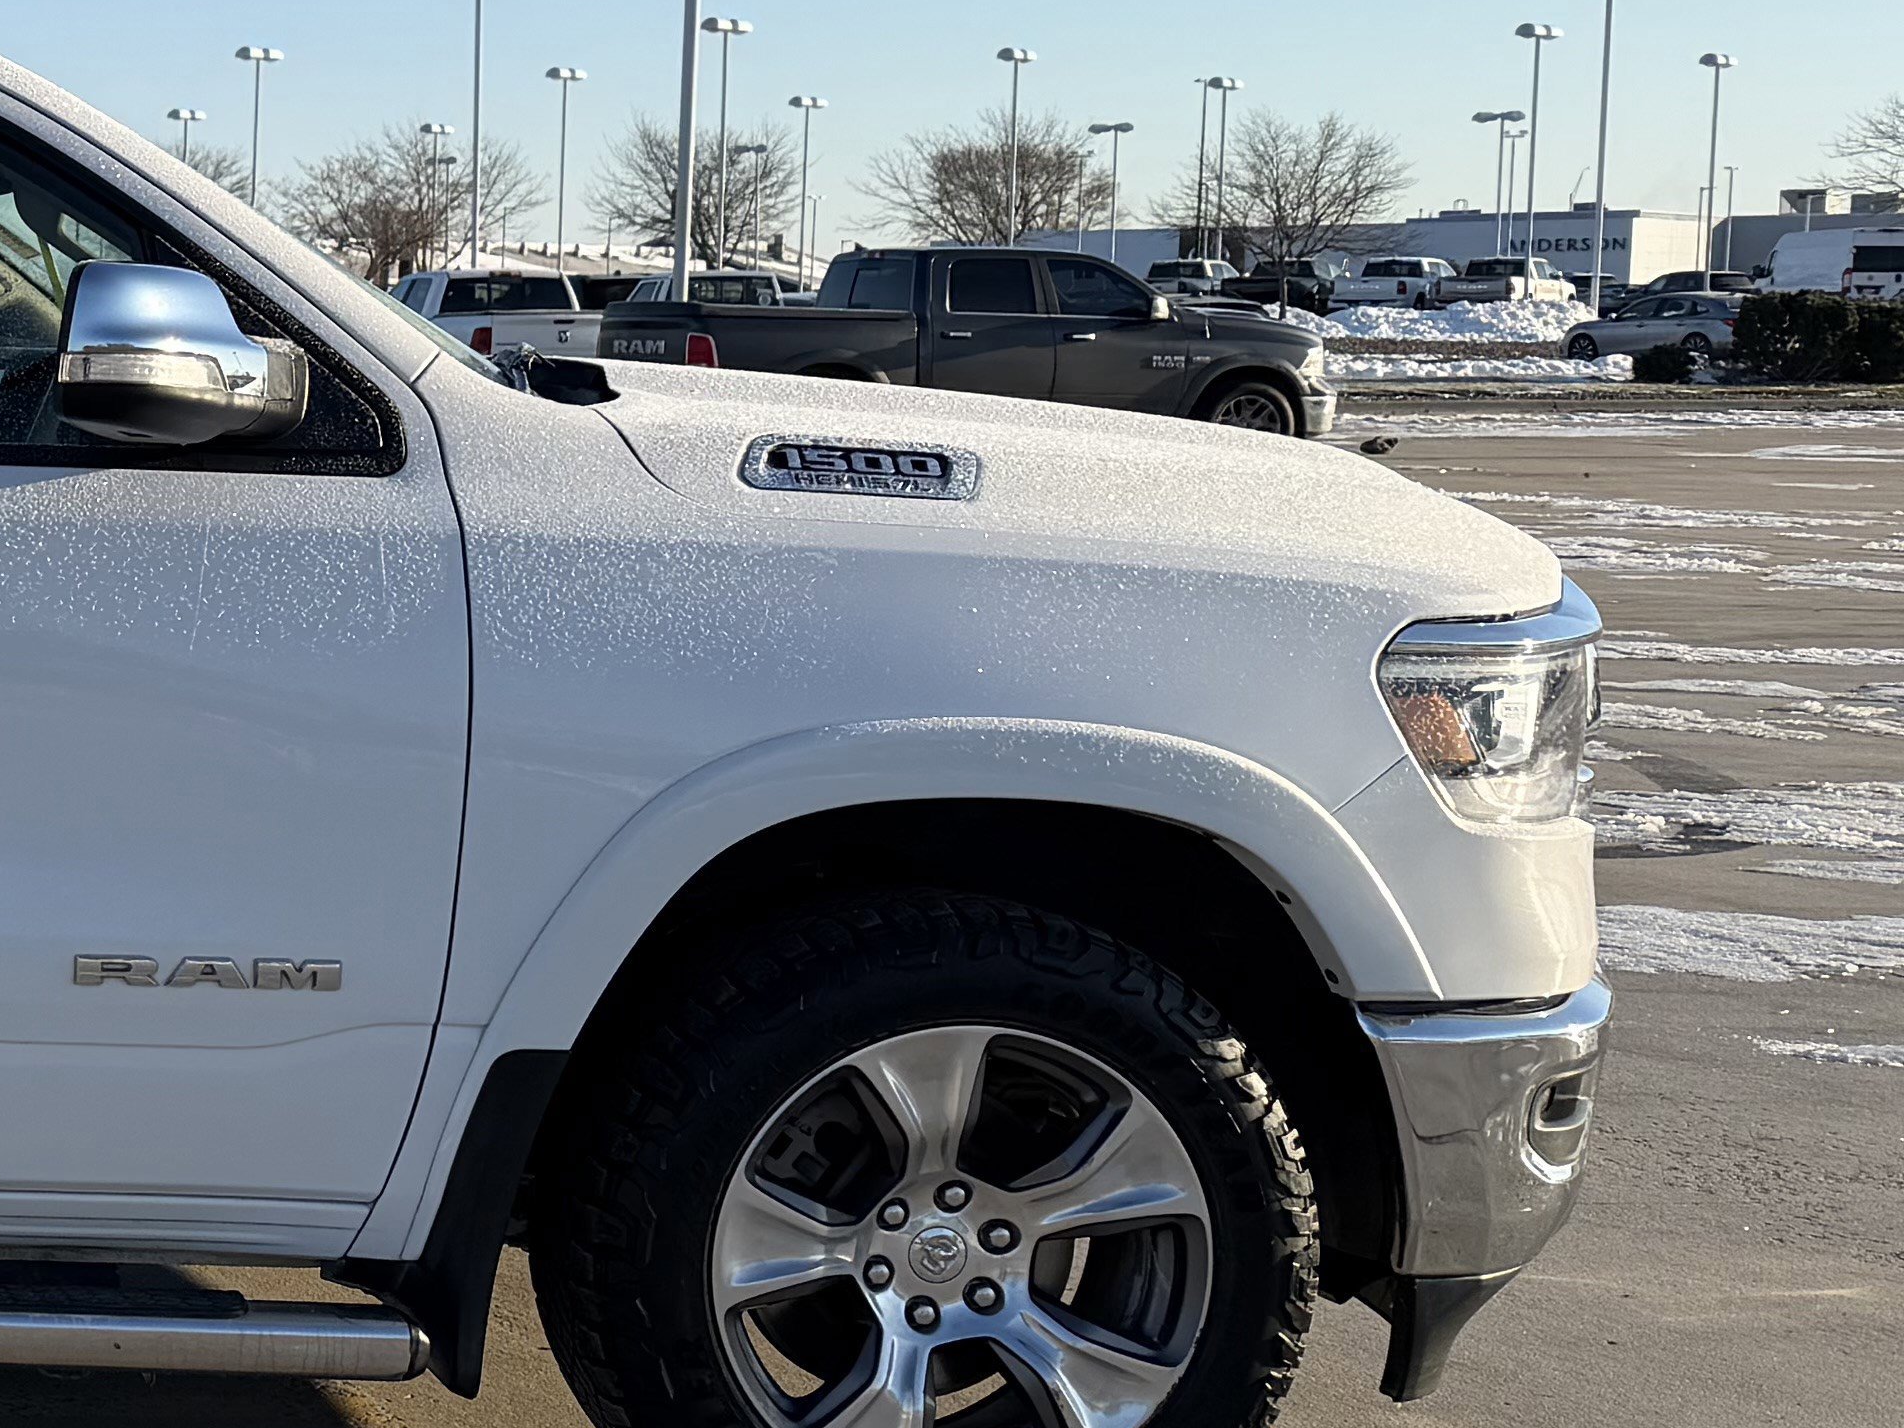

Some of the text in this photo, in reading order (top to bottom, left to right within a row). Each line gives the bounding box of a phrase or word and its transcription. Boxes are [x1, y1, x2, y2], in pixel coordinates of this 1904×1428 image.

[613, 339, 665, 354] RAM
[782, 446, 943, 477] 1500
[73, 953, 343, 992] RAM
